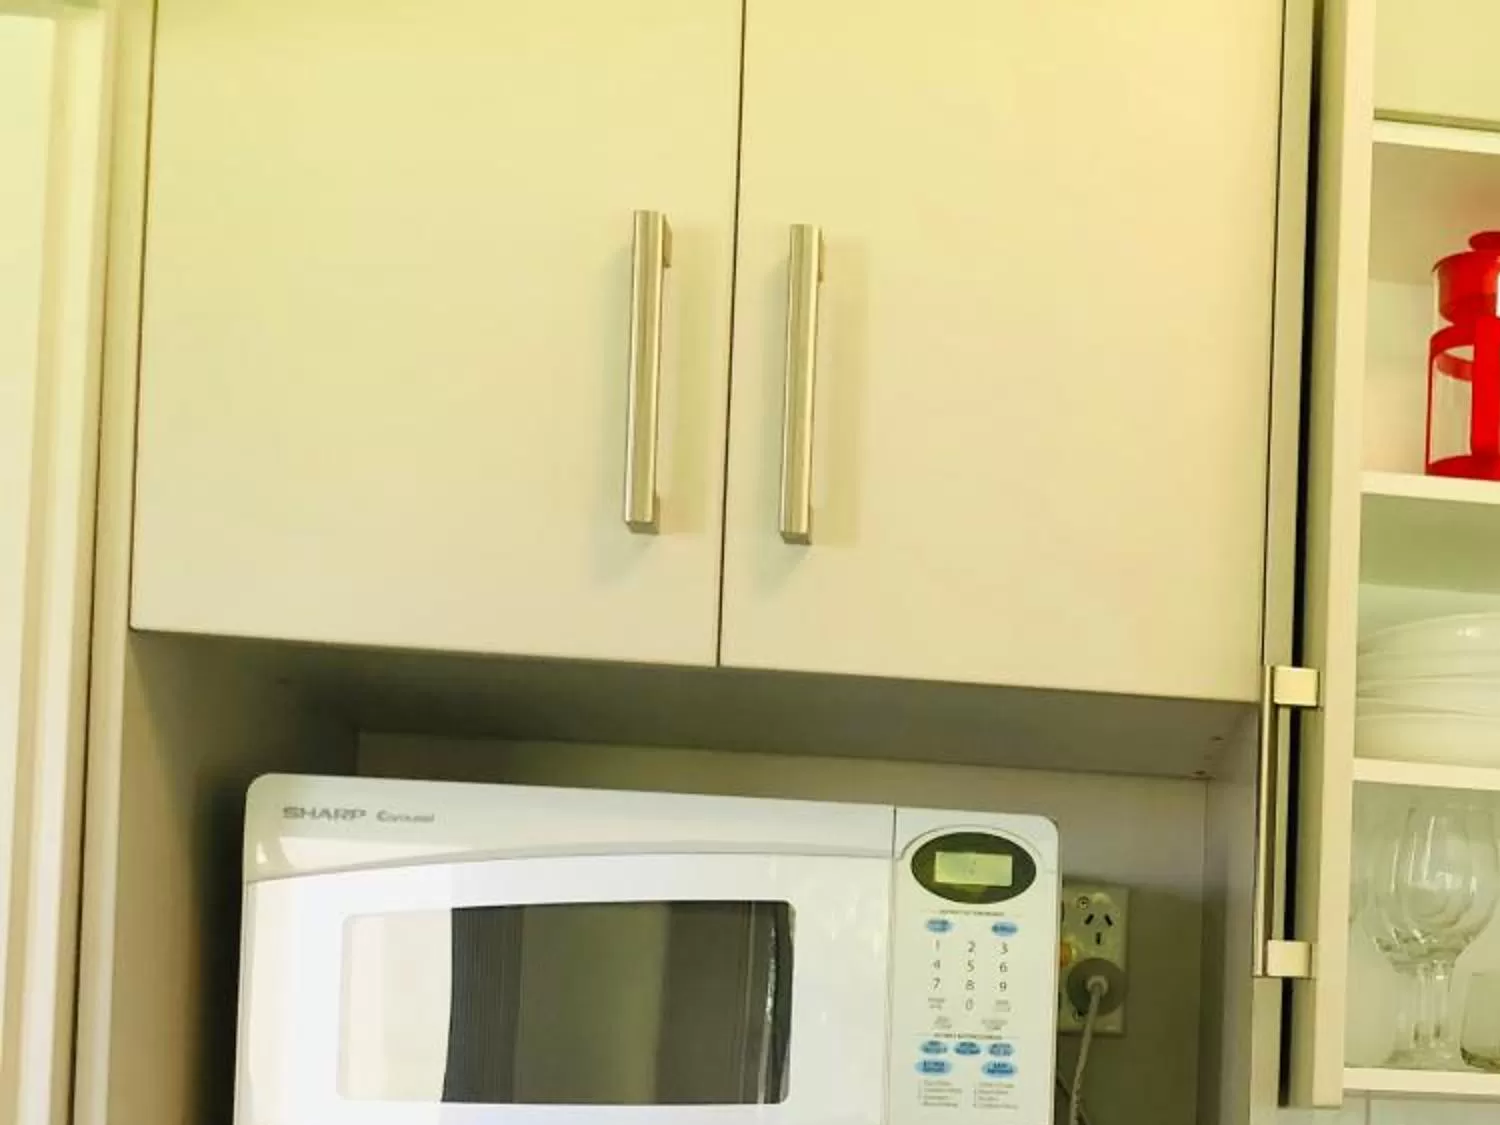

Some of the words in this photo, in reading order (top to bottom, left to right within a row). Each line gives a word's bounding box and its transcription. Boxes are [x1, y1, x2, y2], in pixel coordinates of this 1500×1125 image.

[283, 806, 367, 822] SHARP
[967, 940, 976, 954] 2
[999, 941, 1009, 954] 3
[966, 959, 975, 972] 5
[999, 961, 1009, 973] 6
[932, 977, 941, 990] 7
[965, 978, 975, 990] 8
[999, 980, 1008, 992] 9
